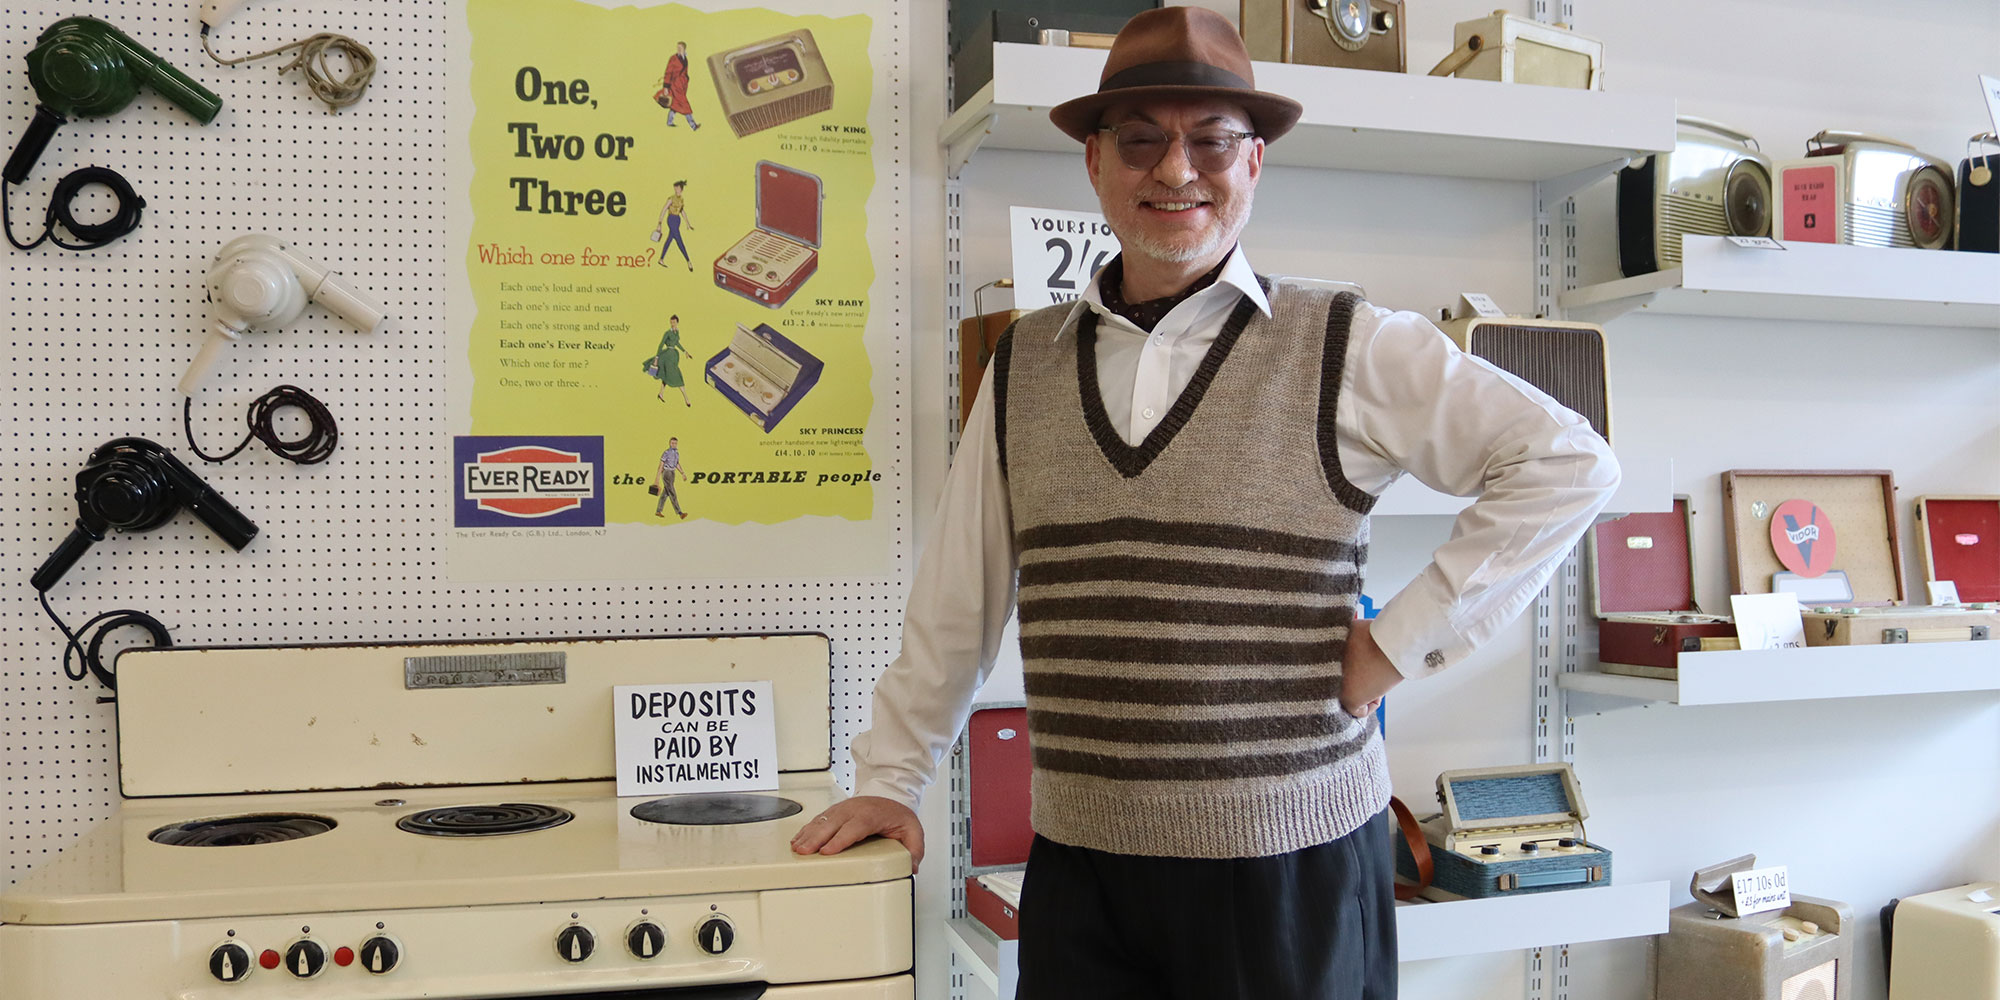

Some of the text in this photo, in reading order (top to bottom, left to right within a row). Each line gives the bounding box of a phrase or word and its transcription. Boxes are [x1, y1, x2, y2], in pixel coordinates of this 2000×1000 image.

[515, 66, 598, 110] One,
[843, 126, 866, 134] KING
[508, 122, 634, 161] Two or
[509, 177, 627, 217] Three
[1031, 217, 1112, 236] YOURS FO
[478, 243, 656, 269] Which one for me?
[500, 282, 620, 294] Each one's loud and sweet
[500, 301, 612, 313] Each one's nice and neat
[815, 298, 864, 307] SKY BABY
[500, 320, 631, 333] Each one's strong and steady
[500, 339, 615, 351] Each one's Ever Ready
[500, 358, 530, 368] Which
[533, 360, 550, 368] one
[553, 359, 565, 368] for
[500, 377, 522, 388] One,
[525, 379, 541, 388] two
[544, 380, 554, 388] or
[556, 378, 580, 388] three
[821, 427, 864, 435] PRINCESS
[468, 465, 590, 493] EVER READY
[612, 469, 882, 486] the PORTABLE people
[490, 530, 509, 539] Ready
[512, 530, 524, 538] Co.
[566, 530, 592, 538] London,
[1789, 526, 1818, 542] VIDOR
[631, 689, 756, 720] DEPOSITS
[661, 720, 729, 733] CAN BE
[654, 733, 737, 760] PAID BY
[636, 759, 759, 784] INSTALMENTS!
[1737, 877, 1753, 895] £17
[1756, 875, 1772, 891] 10s
